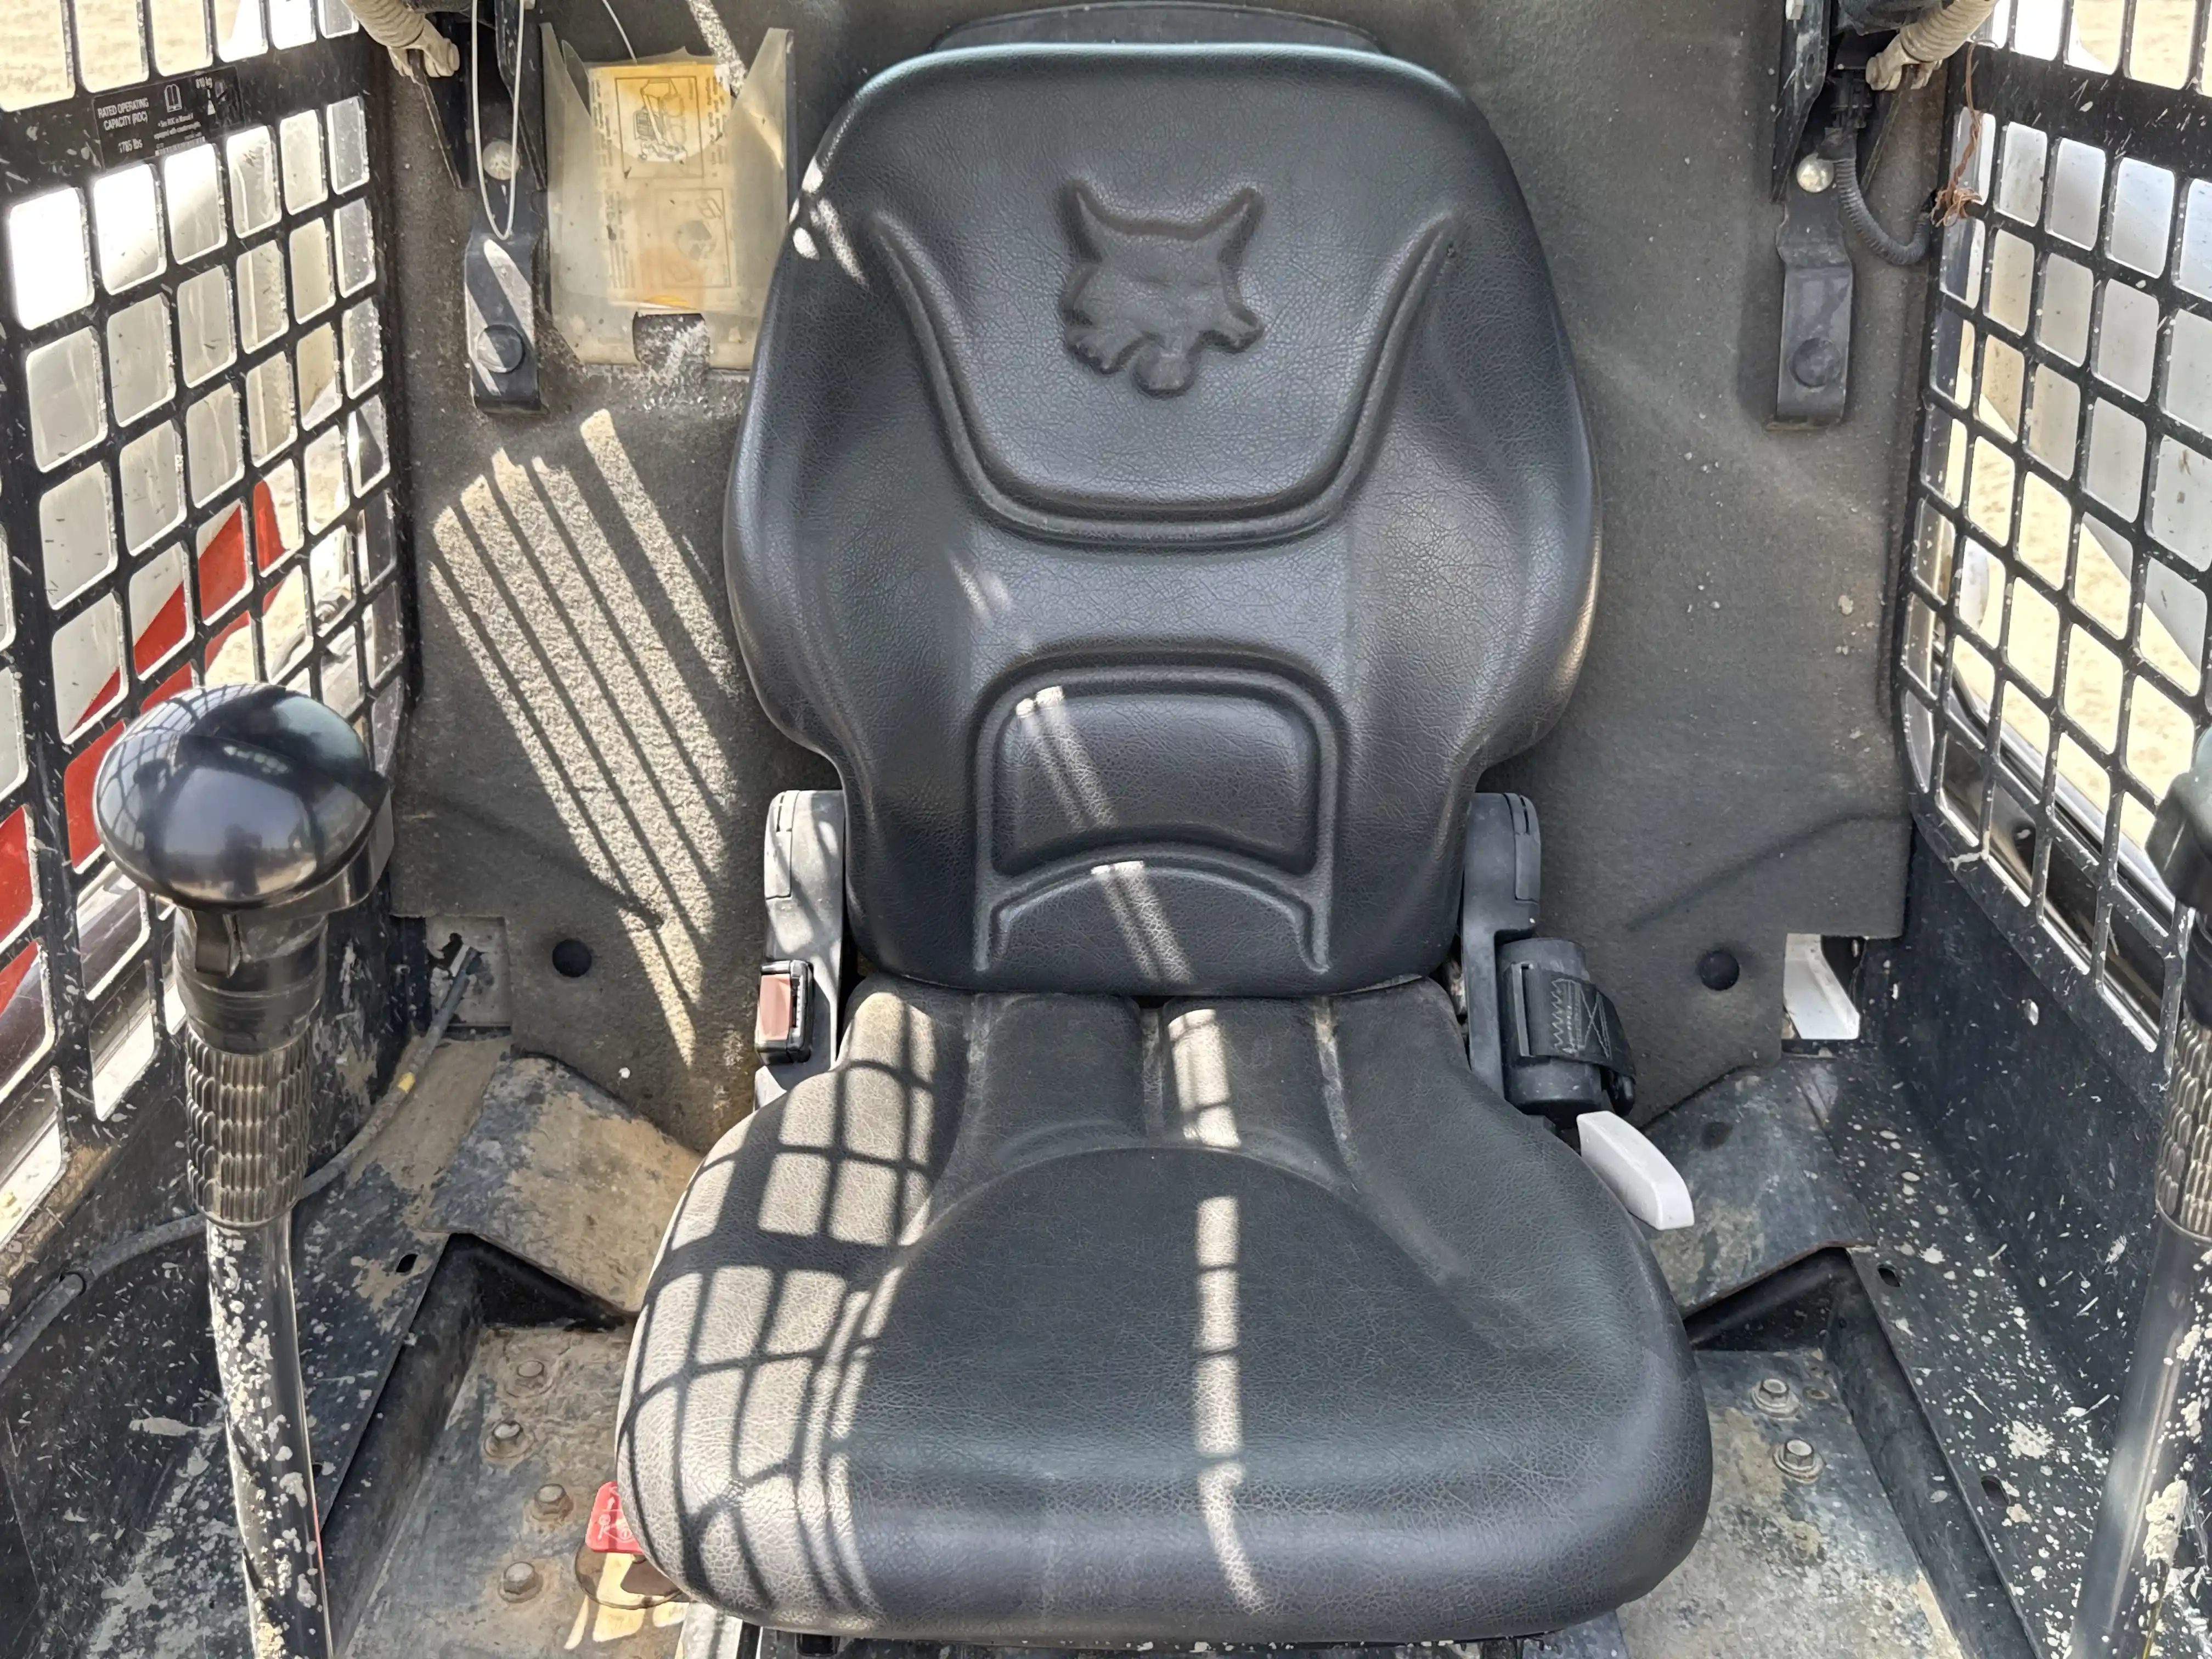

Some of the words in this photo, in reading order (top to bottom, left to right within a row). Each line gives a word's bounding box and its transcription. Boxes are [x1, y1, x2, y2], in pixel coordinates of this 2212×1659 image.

[97, 105, 117, 119] RATED
[117, 97, 150, 114] OPERATING
[103, 115, 132, 131] CAPACITY
[132, 110, 148, 126] (ROC)
[133, 138, 143, 150] lbs
